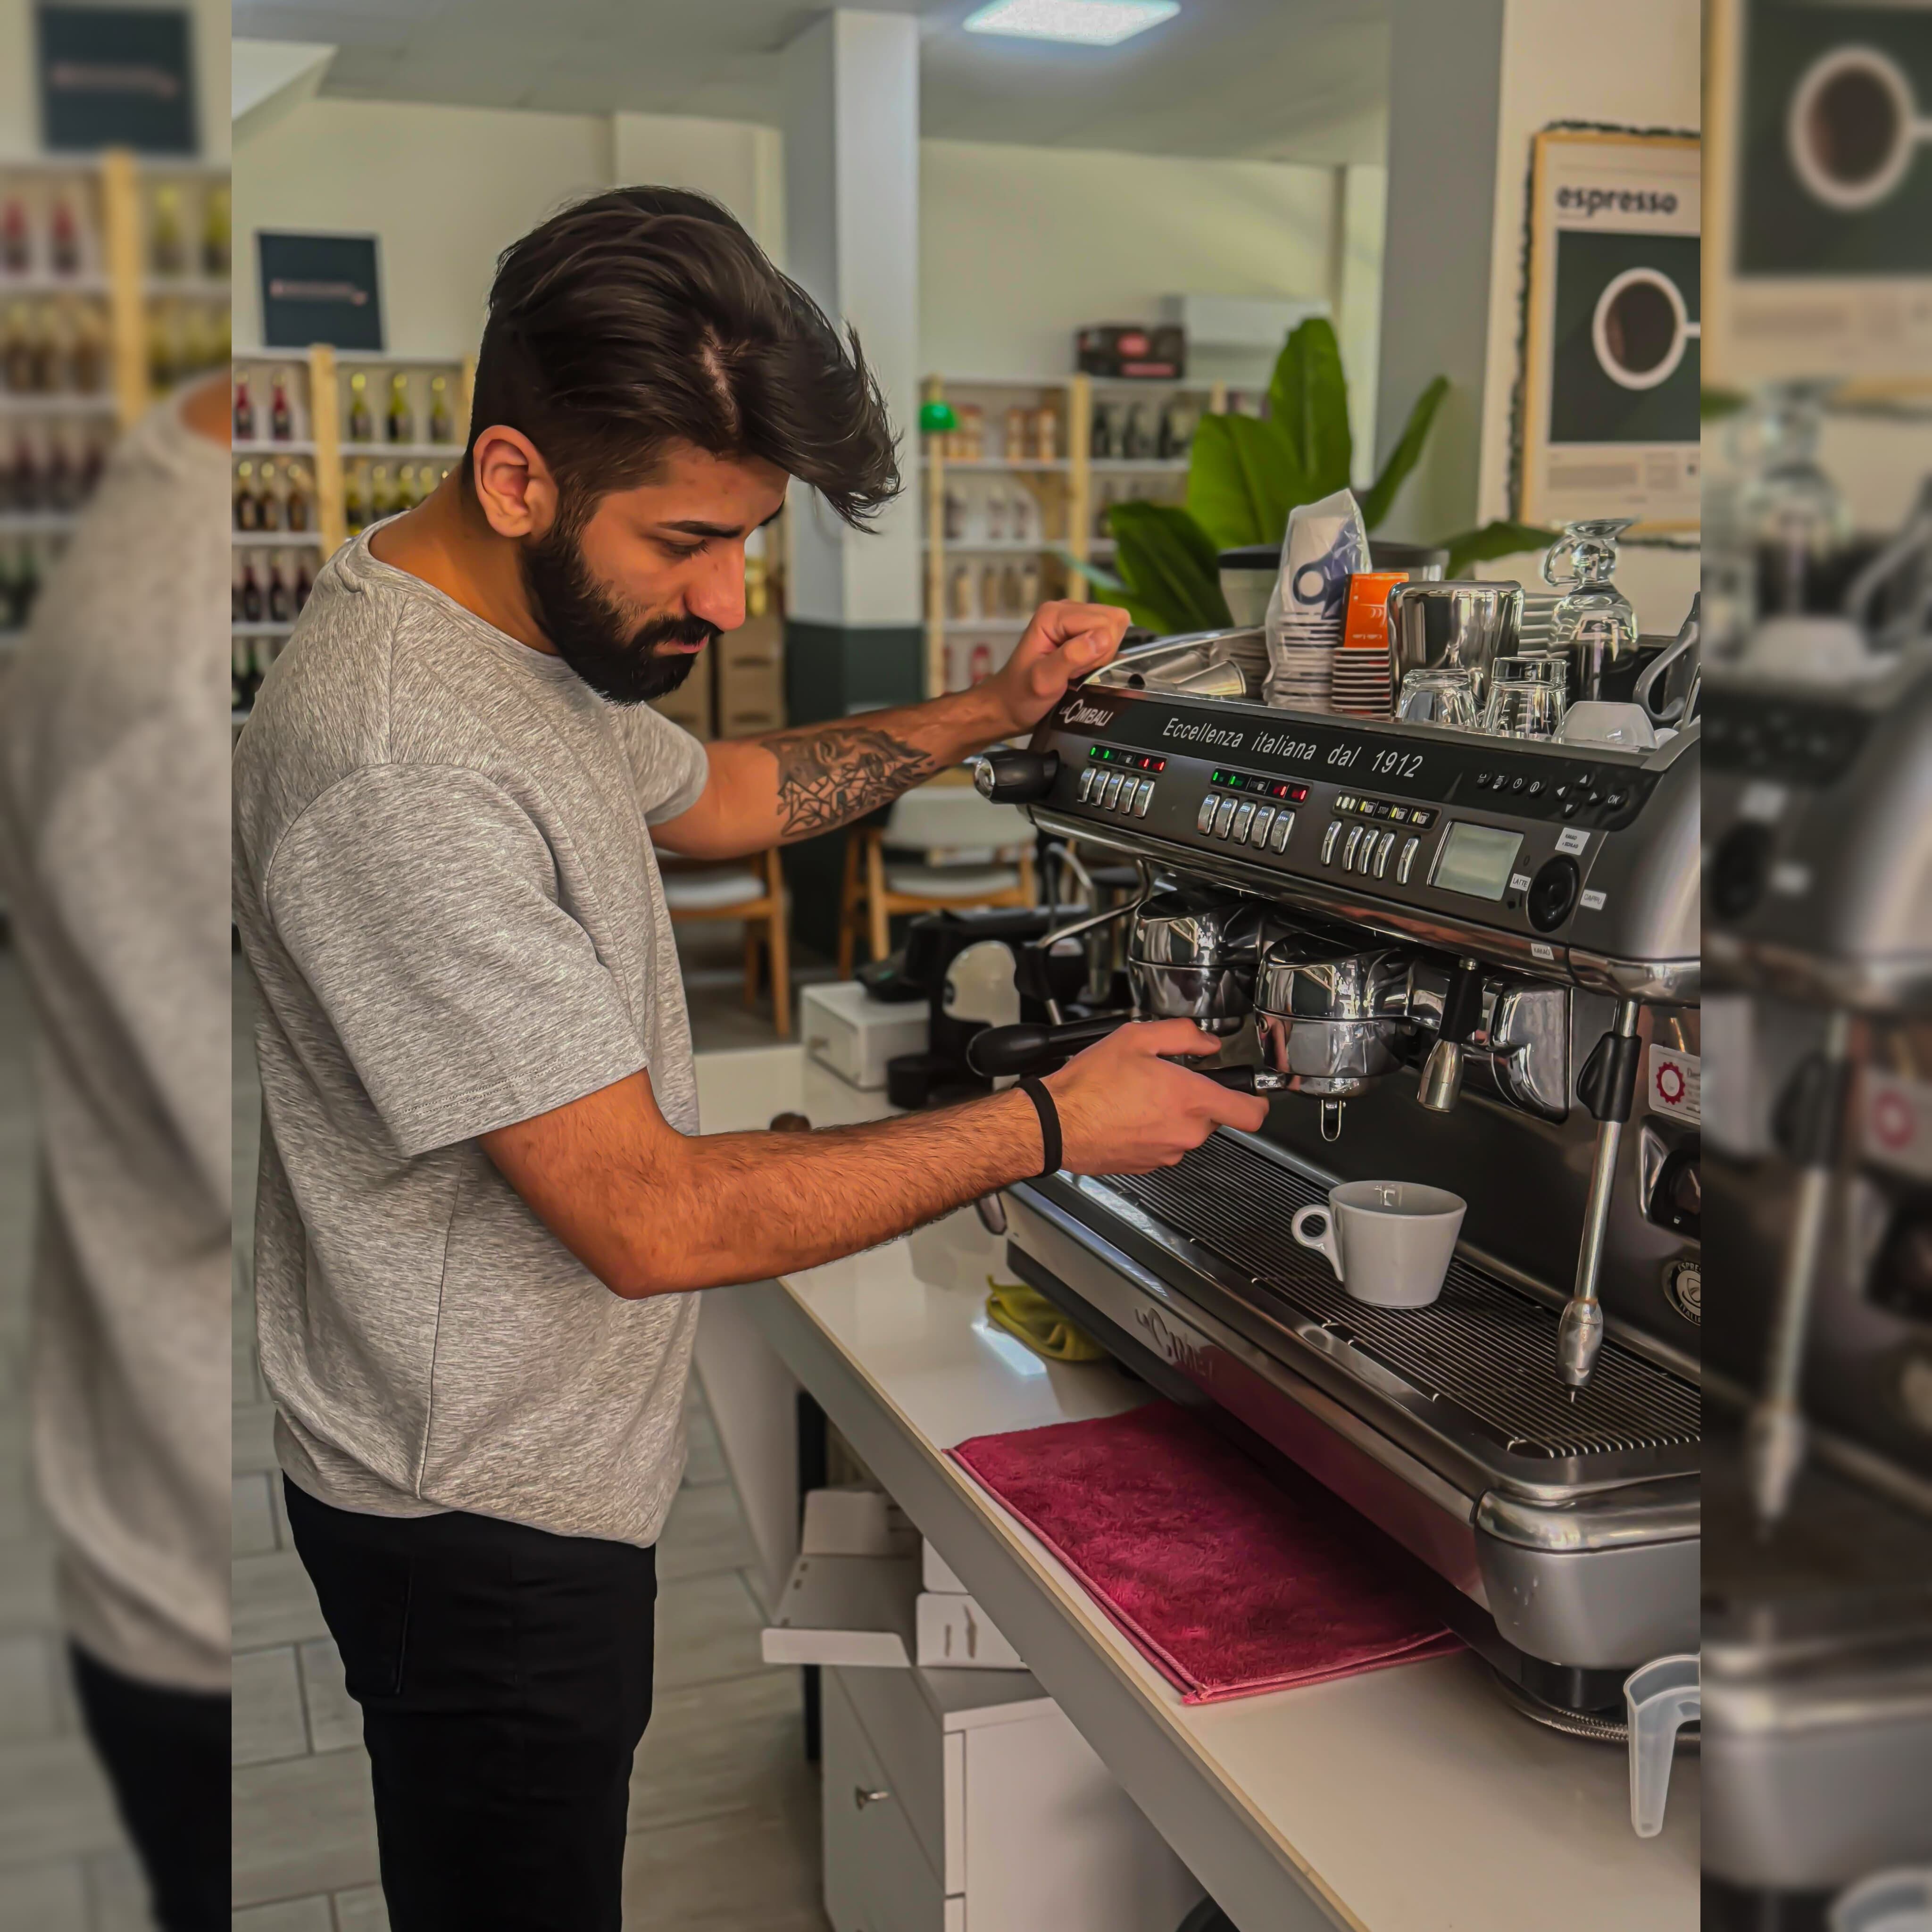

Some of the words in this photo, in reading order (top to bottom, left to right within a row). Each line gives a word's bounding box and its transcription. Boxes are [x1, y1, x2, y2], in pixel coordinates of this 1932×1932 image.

[1556, 185, 1678, 217] espresso
[1162, 717, 1244, 748] Eccellenza
[1251, 731, 1317, 761] italiana
[1327, 743, 1362, 768] dal
[1372, 749, 1424, 778] 1912
[1607, 795, 1621, 804] OK
[1513, 878, 1528, 888] LATTE
[1678, 1262, 1700, 1273] ESPRE
